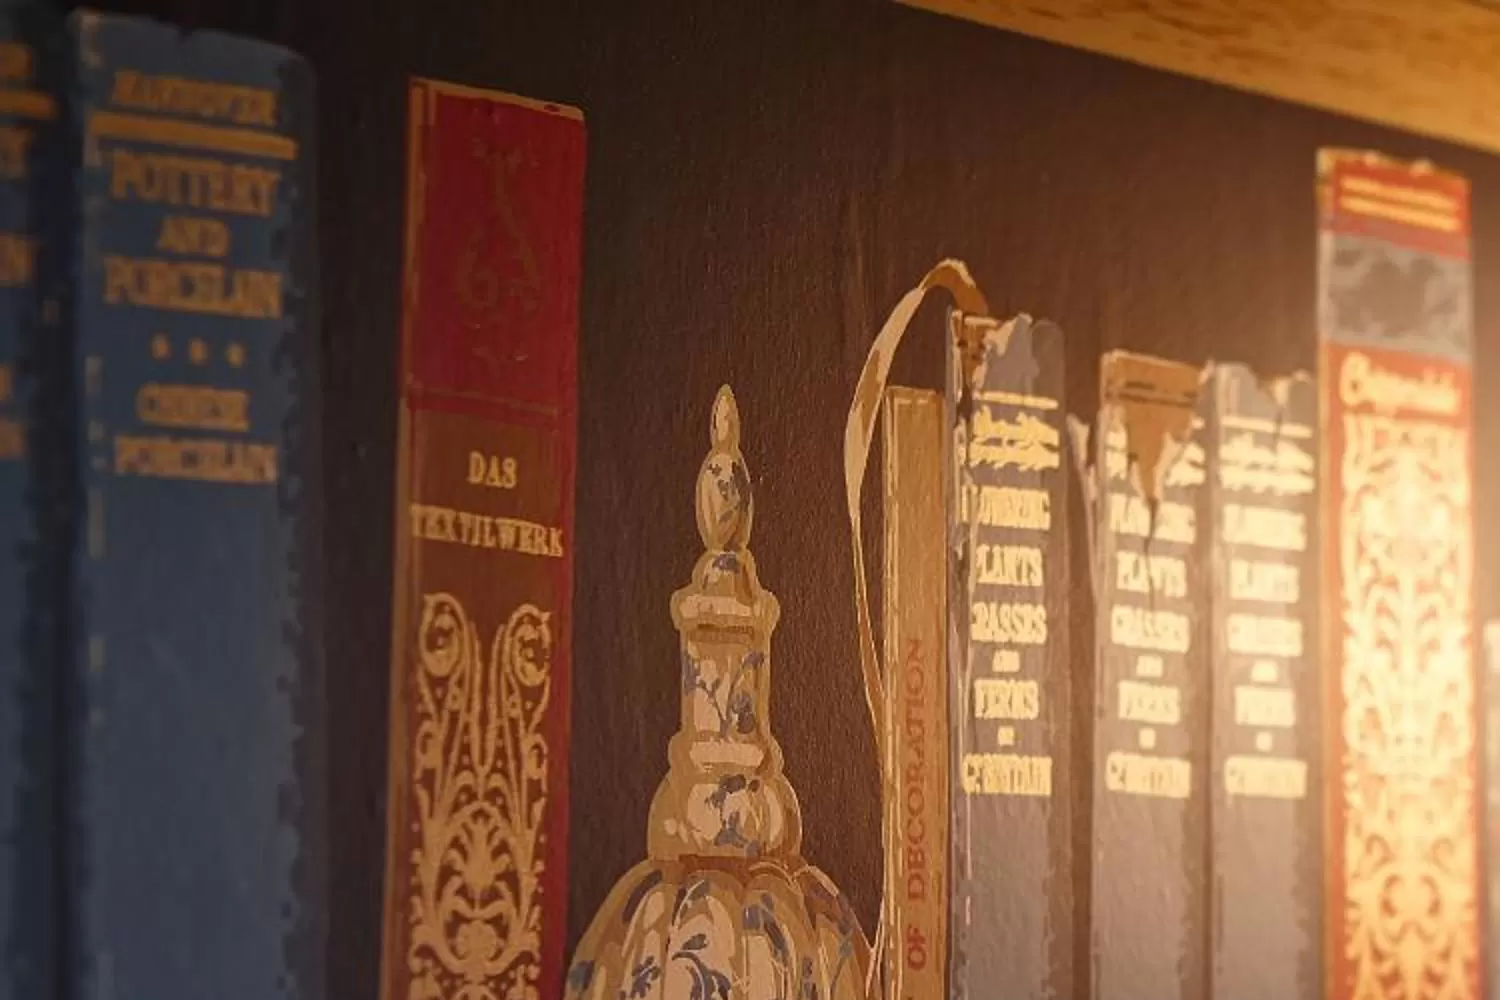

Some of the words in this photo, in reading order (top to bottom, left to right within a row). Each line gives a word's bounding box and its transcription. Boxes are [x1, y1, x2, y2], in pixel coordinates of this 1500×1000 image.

[111, 149, 281, 217] POTTERY
[155, 216, 231, 258] AND
[467, 450, 518, 489] DAS
[411, 504, 563, 557] TEXTILWERK
[905, 638, 926, 900] DECORATION
[906, 923, 928, 971] OF
